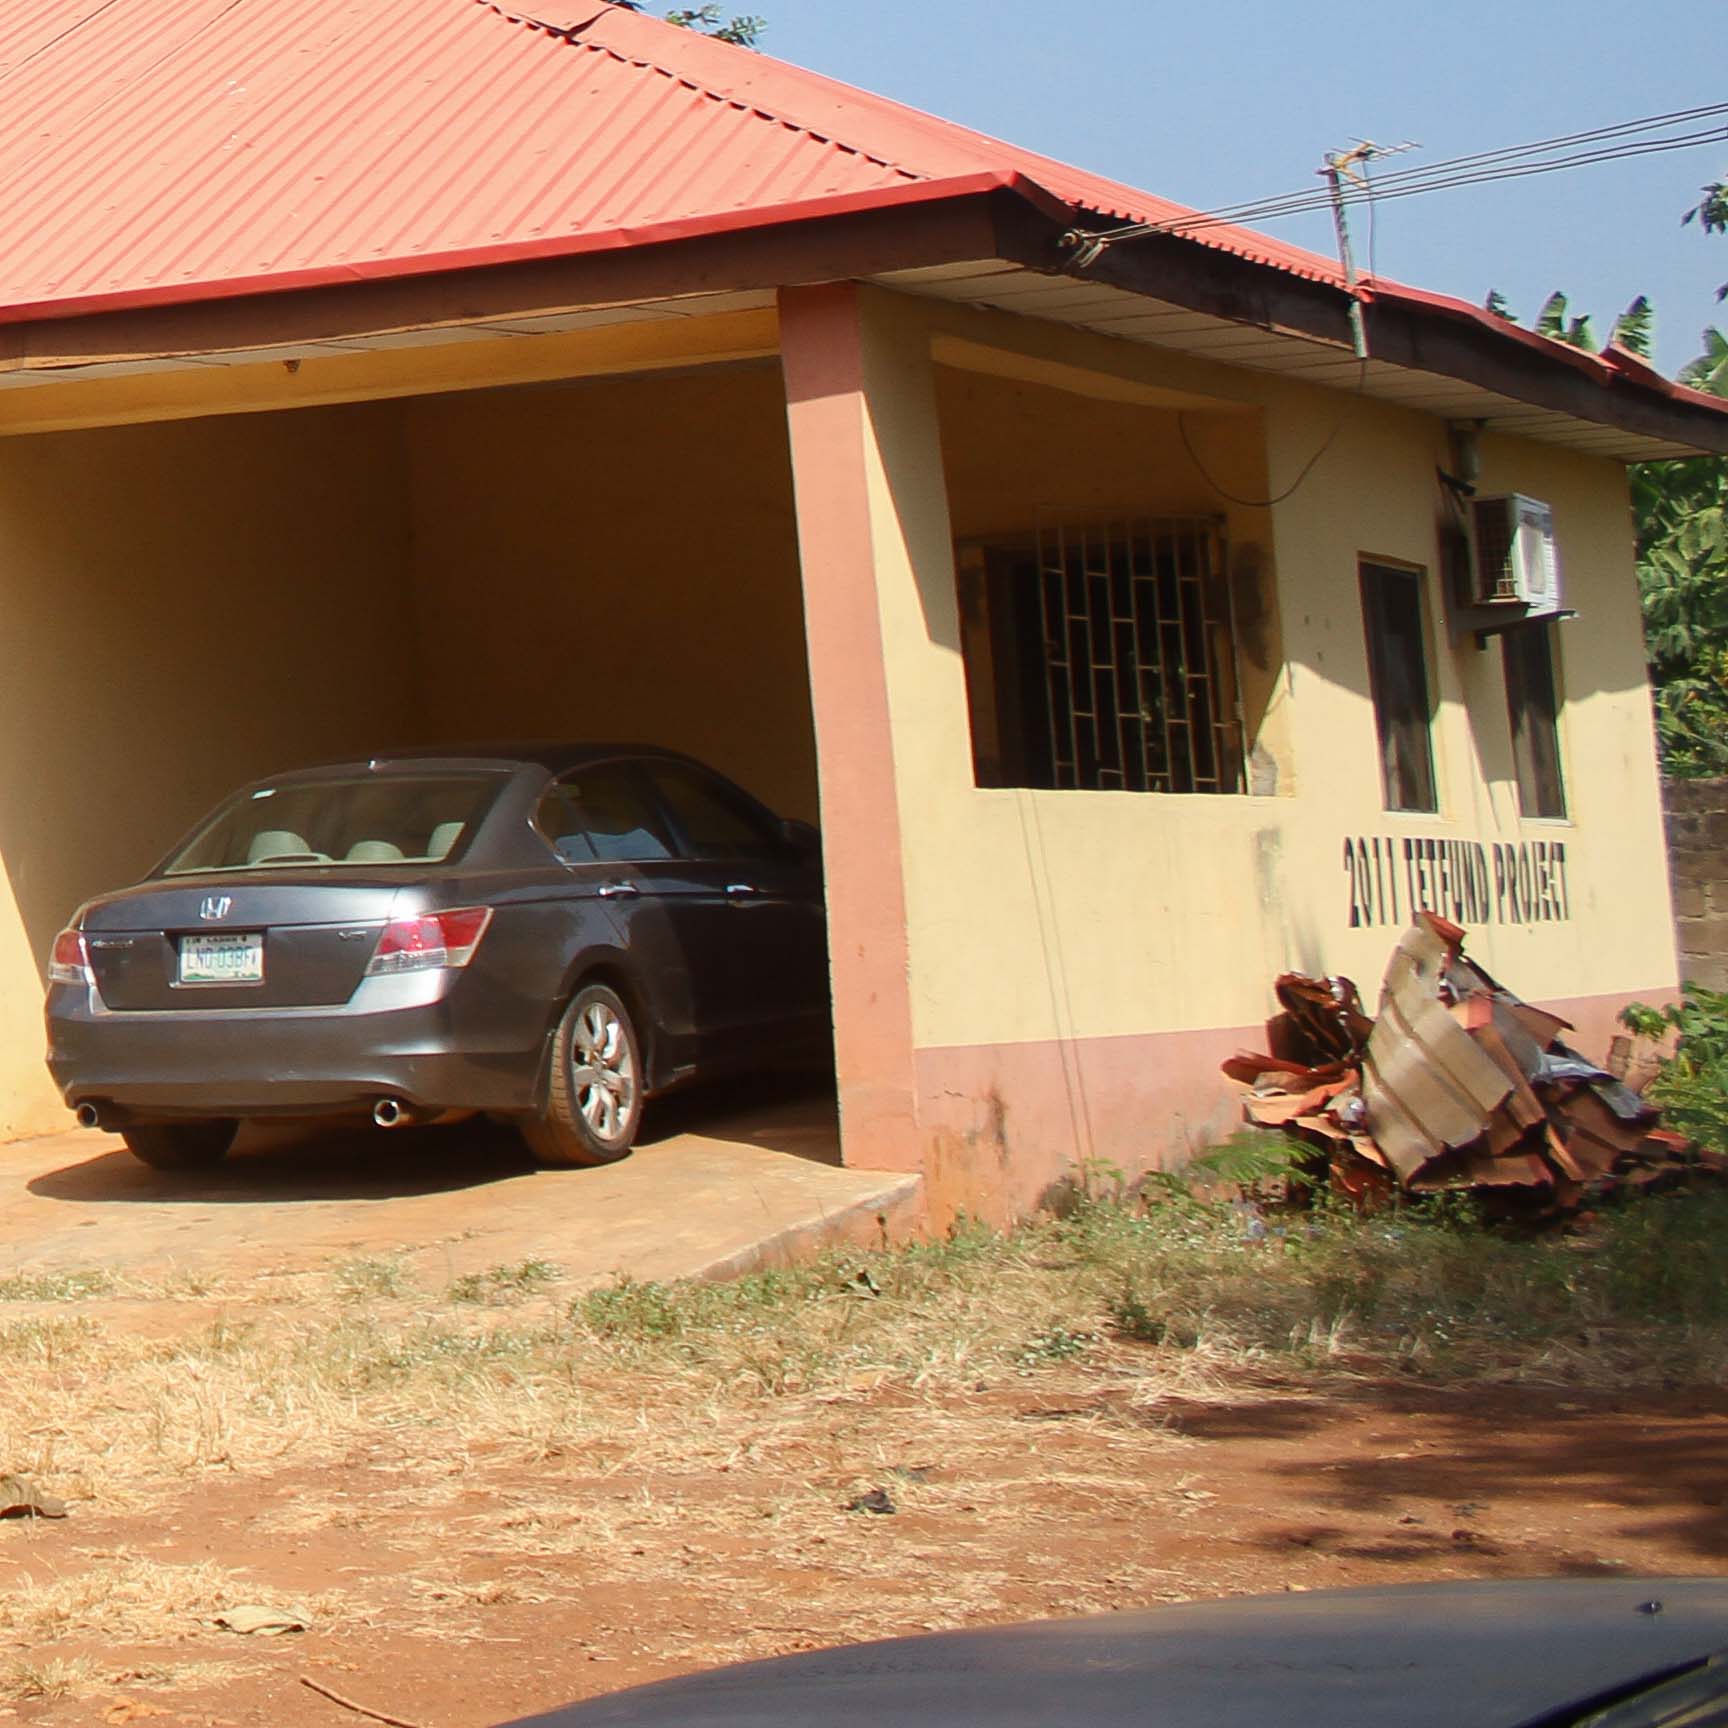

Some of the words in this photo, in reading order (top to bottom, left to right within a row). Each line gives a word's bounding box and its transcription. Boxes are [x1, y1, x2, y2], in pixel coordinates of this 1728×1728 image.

[1344, 836, 1398, 928] 2011
[1402, 837, 1490, 924] TETFUND
[1492, 840, 1570, 925] PROJECT
